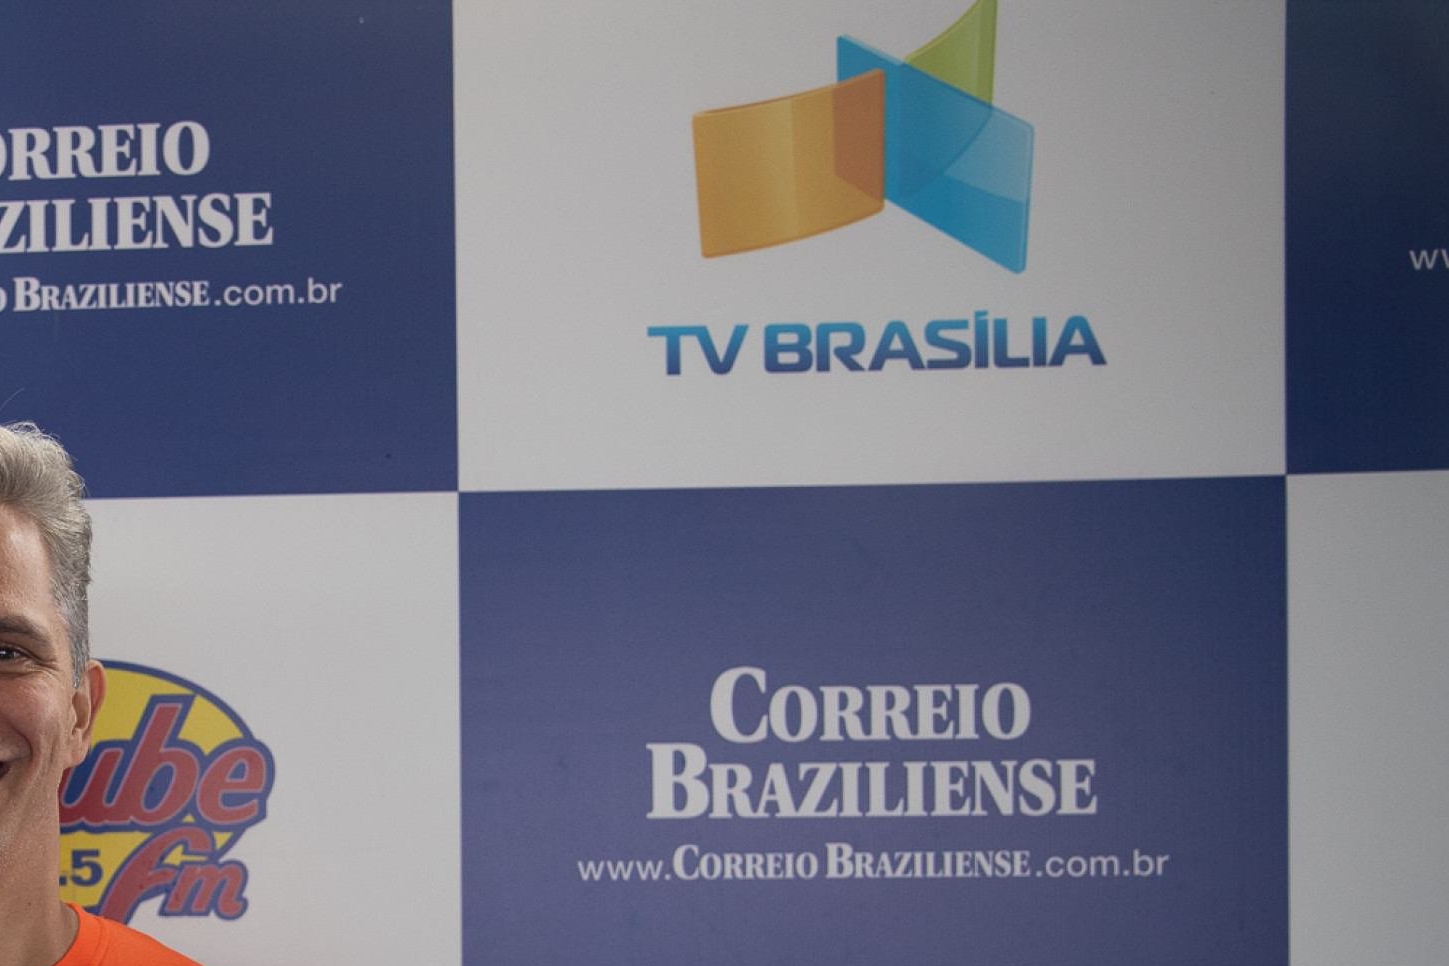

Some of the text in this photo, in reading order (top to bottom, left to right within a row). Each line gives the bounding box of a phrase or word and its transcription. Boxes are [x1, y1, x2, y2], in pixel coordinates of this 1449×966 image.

[647, 310, 1107, 375] TV BRASÍLIA
[710, 666, 1031, 744] CORREIO
[646, 743, 1098, 819] BRAZILIENSE
[98, 825, 248, 925] fm
